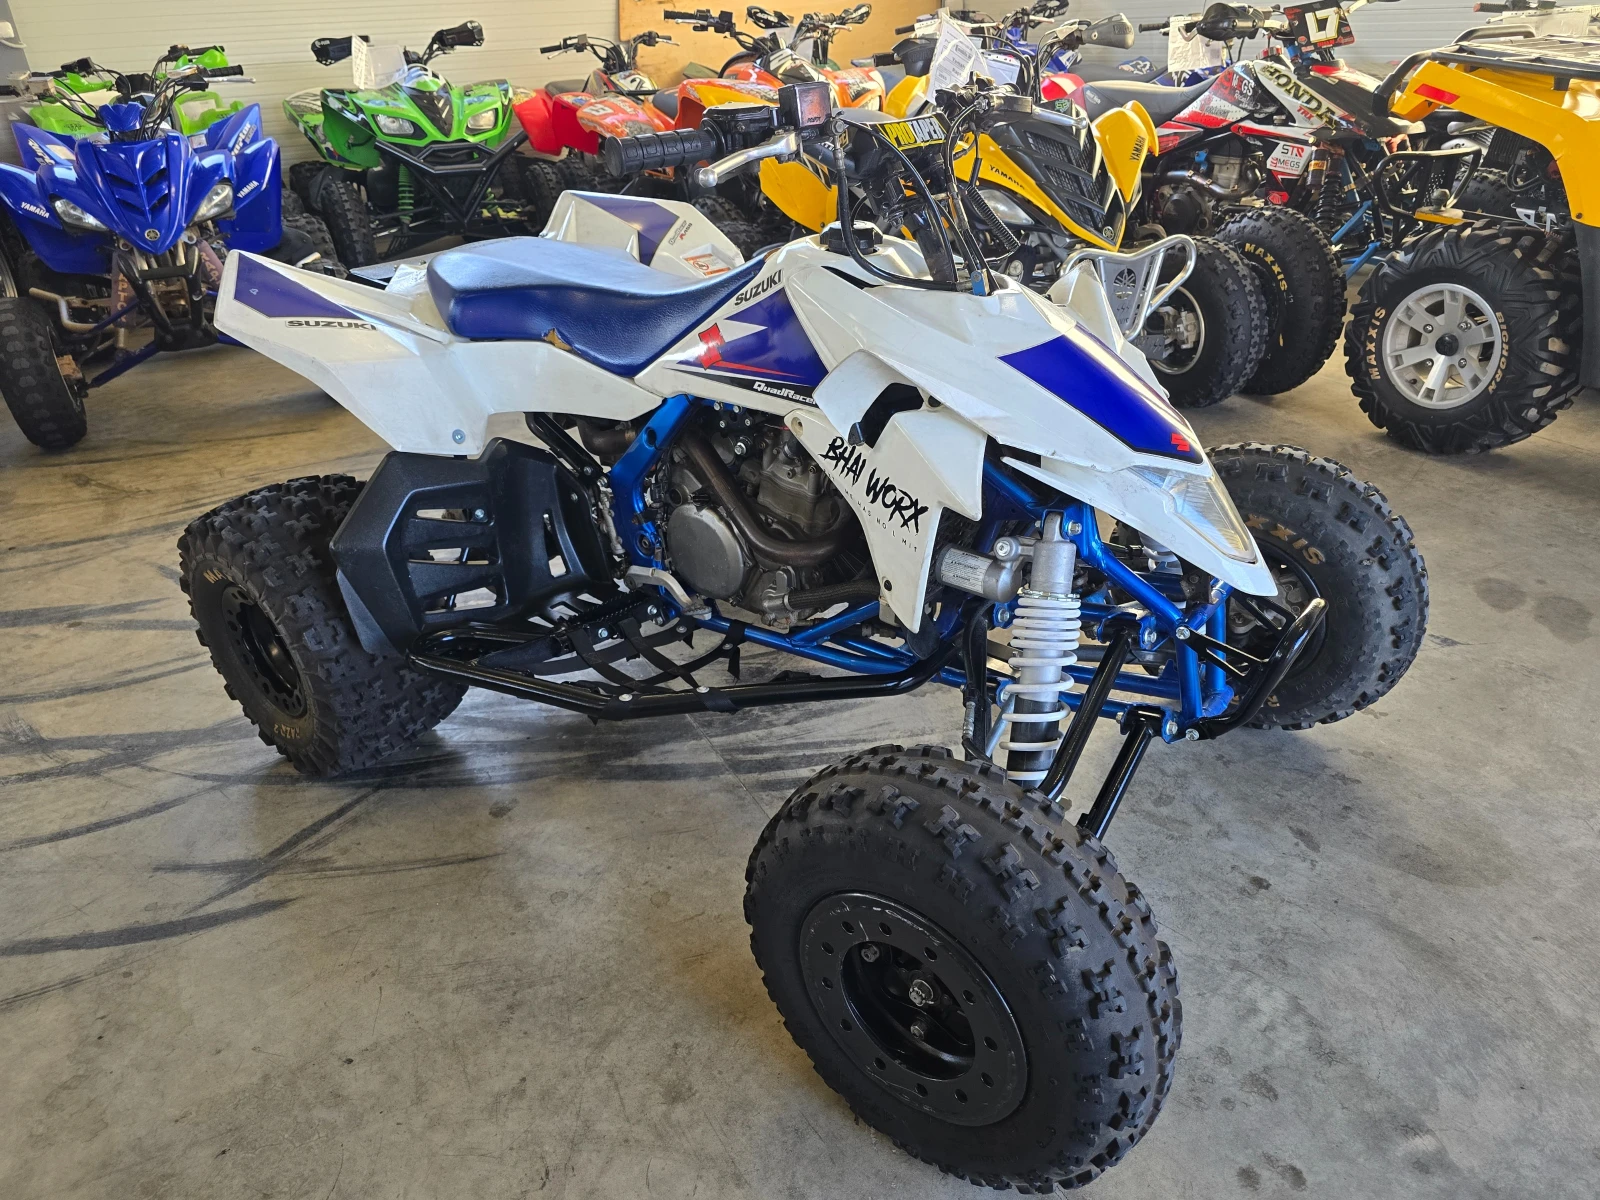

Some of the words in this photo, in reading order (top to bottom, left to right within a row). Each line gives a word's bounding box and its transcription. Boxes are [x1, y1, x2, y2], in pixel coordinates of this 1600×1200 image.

[1260, 65, 1337, 129] HONDA
[1129, 135, 1147, 162] YAMAHA
[1278, 158, 1300, 169] MEGS
[237, 180, 260, 198] YAMAHA
[988, 164, 1026, 190] YAMAHA
[20, 201, 50, 219] YAMAHA
[1244, 243, 1288, 291] MAXXIS
[735, 269, 783, 306] SUZUKI
[287, 320, 378, 331] SUZUKI
[1366, 307, 1386, 380] MAXXIS
[1488, 311, 1509, 394] BIGHORN
[818, 436, 867, 487] BHAI
[865, 467, 929, 536] WORX
[892, 530, 918, 553] LMIT
[1244, 513, 1326, 565] XXIS
